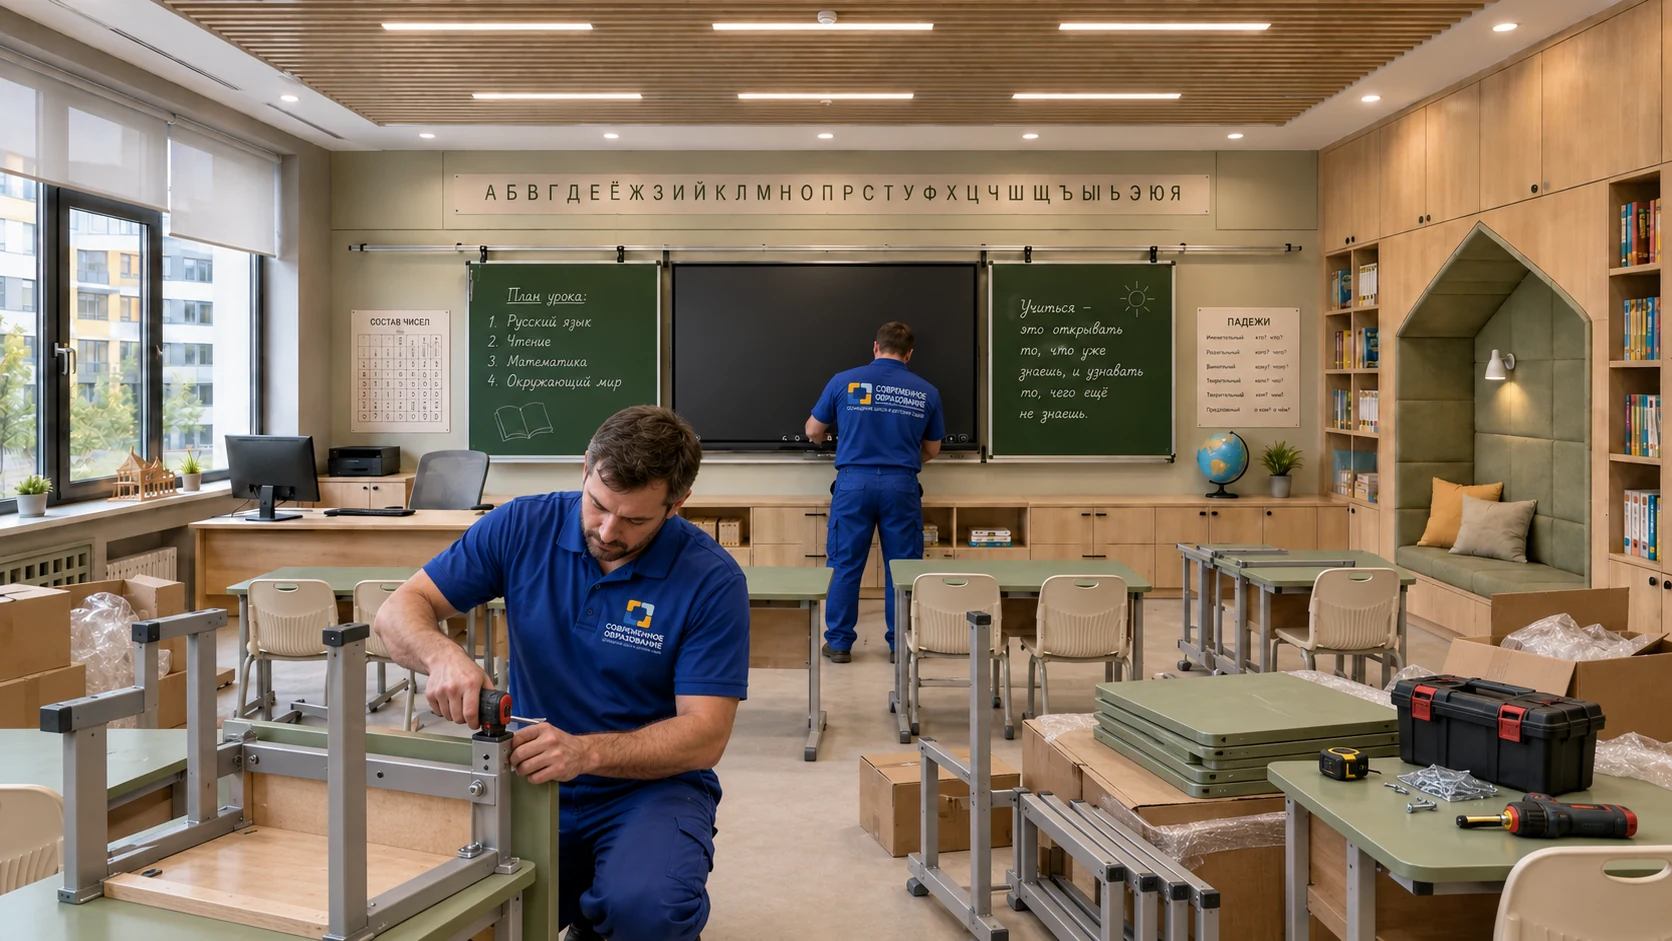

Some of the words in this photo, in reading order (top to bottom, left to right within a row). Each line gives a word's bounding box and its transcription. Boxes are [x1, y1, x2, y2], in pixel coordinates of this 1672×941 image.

[506, 287, 542, 304] План
[547, 292, 587, 306] урока:
[1020, 298, 1076, 319] Учиться
[370, 318, 401, 326] СОСТАВ
[403, 318, 430, 326] ЧИСЕЛ
[488, 315, 498, 328] 1.
[507, 314, 557, 331] Русский
[562, 317, 592, 331] язык
[1020, 325, 1044, 335] это
[1052, 321, 1123, 338] открывать
[1227, 317, 1271, 328] ПАДЕЖИ
[487, 335, 499, 347] 2.
[507, 334, 551, 347] Чтение
[487, 355, 498, 367] 3.
[506, 355, 588, 367] Математика
[1020, 346, 1041, 358] то,
[1050, 345, 1075, 356] что
[1080, 346, 1106, 361] уже
[1019, 367, 1067, 382] знаешь,
[1072, 368, 1080, 377] и
[1086, 363, 1144, 381] узнавать
[487, 374, 498, 387] 4.
[506, 374, 591, 391] Окружающий
[596, 378, 622, 391] мир
[1020, 389, 1042, 400] то,
[1050, 389, 1076, 398] чего
[1084, 386, 1109, 401] ещё
[1019, 410, 1034, 419] не
[1040, 410, 1088, 424] знаешь.
